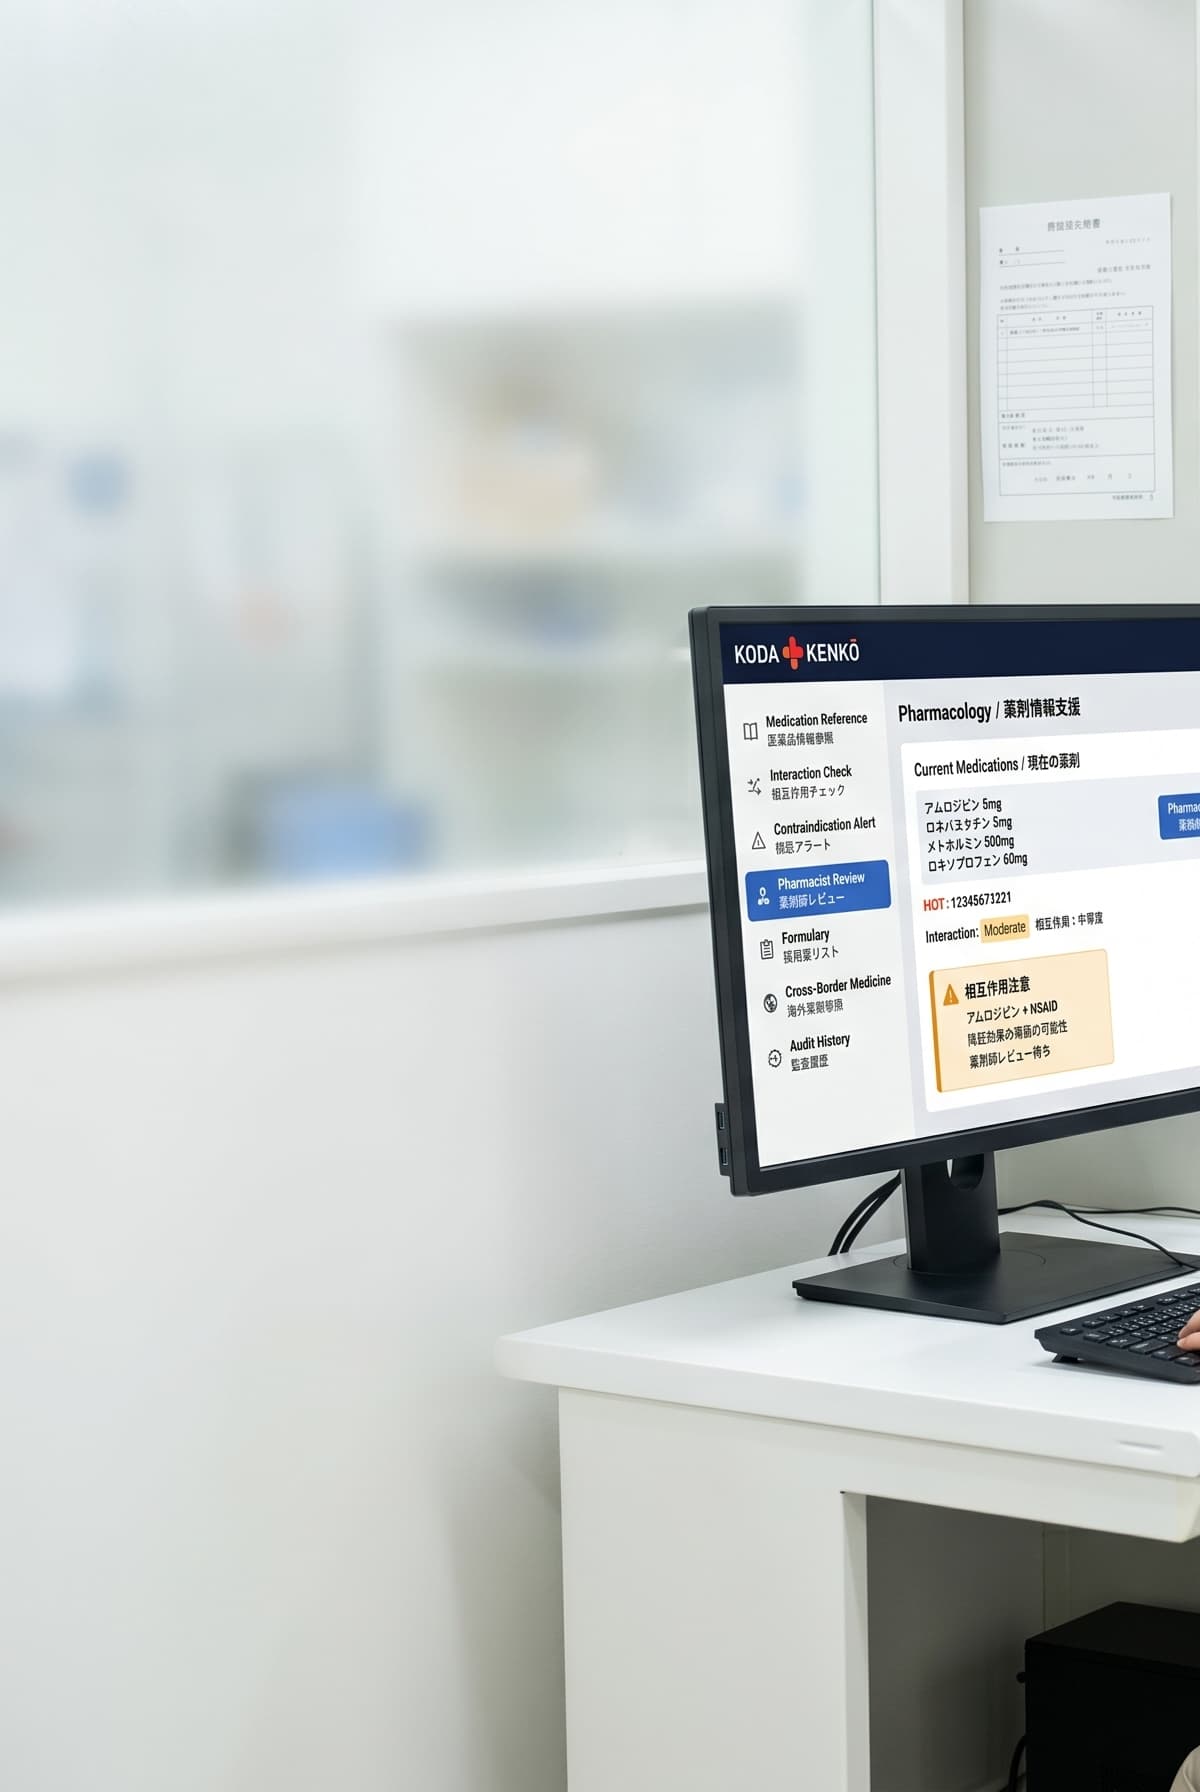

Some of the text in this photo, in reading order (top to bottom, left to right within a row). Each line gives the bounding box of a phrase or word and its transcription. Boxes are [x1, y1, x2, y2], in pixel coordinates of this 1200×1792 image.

[734, 644, 780, 664] KODA
[766, 712, 868, 728] Medication Reference
[898, 701, 992, 723] Pharmacology
[770, 764, 853, 781] Interaction Check
[914, 762, 954, 777] Current
[956, 757, 1019, 774] Medications
[982, 797, 1002, 812] 5mg
[853, 816, 877, 829] Alert
[928, 835, 1015, 853] メトホルミン 500mg
[1003, 852, 1028, 867] 60mg
[777, 871, 865, 890] Pharmacist Review
[781, 928, 830, 945] Formulary
[925, 927, 980, 944] Interaction:
[984, 921, 1027, 937] Moderate
[785, 974, 892, 998] Cross-Border Medicine
[964, 976, 1031, 1000] 相互作用注意
[1030, 1000, 1058, 1015] NSAID
[790, 1036, 815, 1052] Audit
